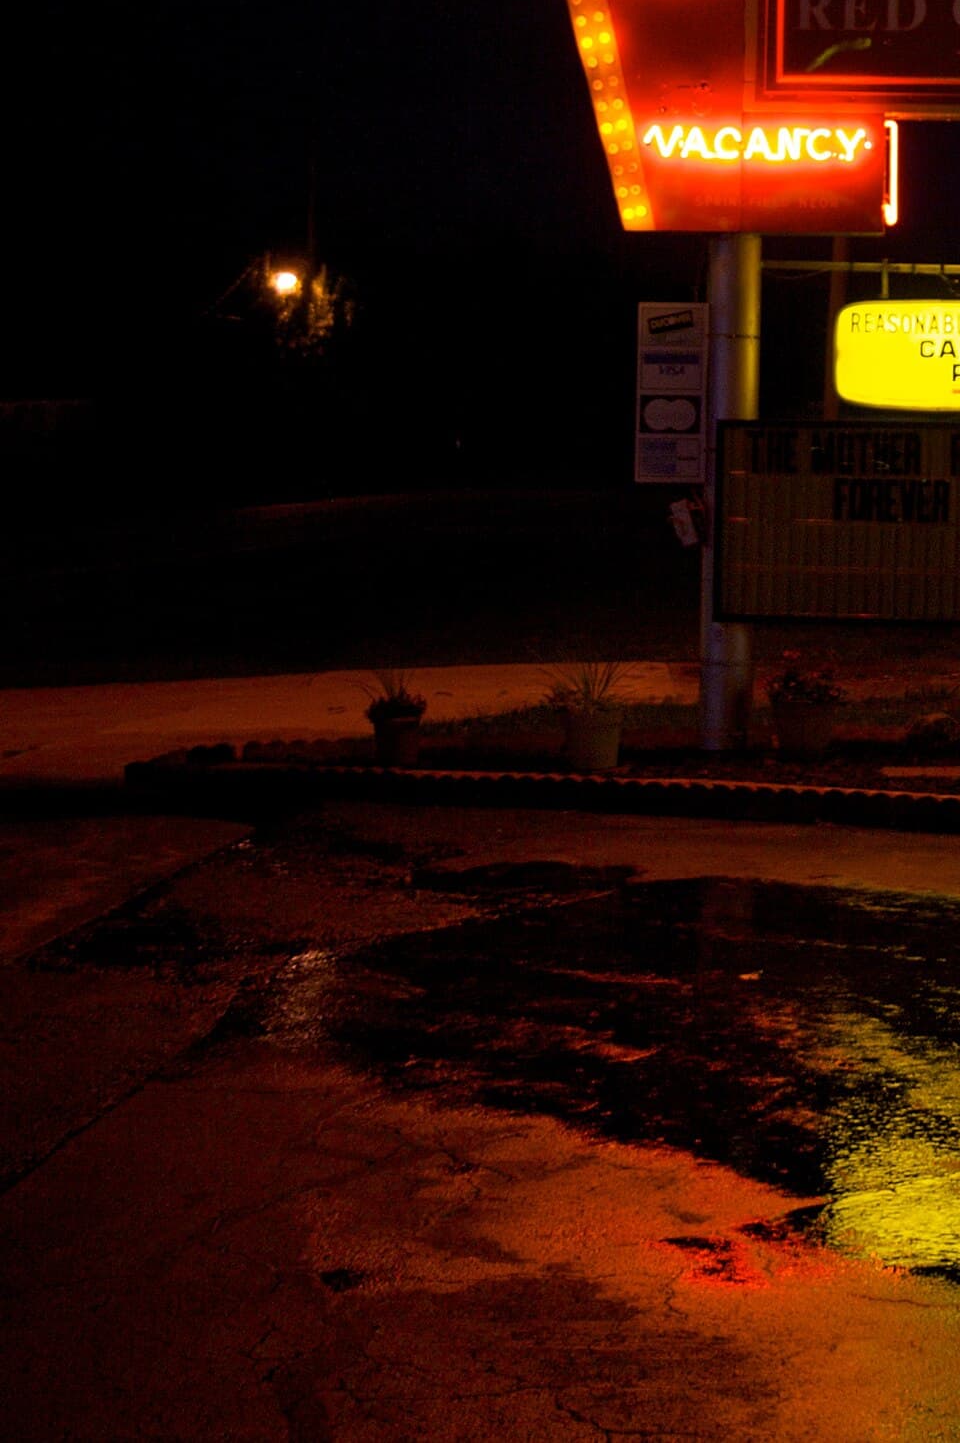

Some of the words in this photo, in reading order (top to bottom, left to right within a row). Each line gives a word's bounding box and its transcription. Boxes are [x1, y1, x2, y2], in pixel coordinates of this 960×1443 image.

[643, 125, 867, 162] VACANCY
[749, 429, 798, 474] THE
[834, 478, 950, 522] FOREVER
